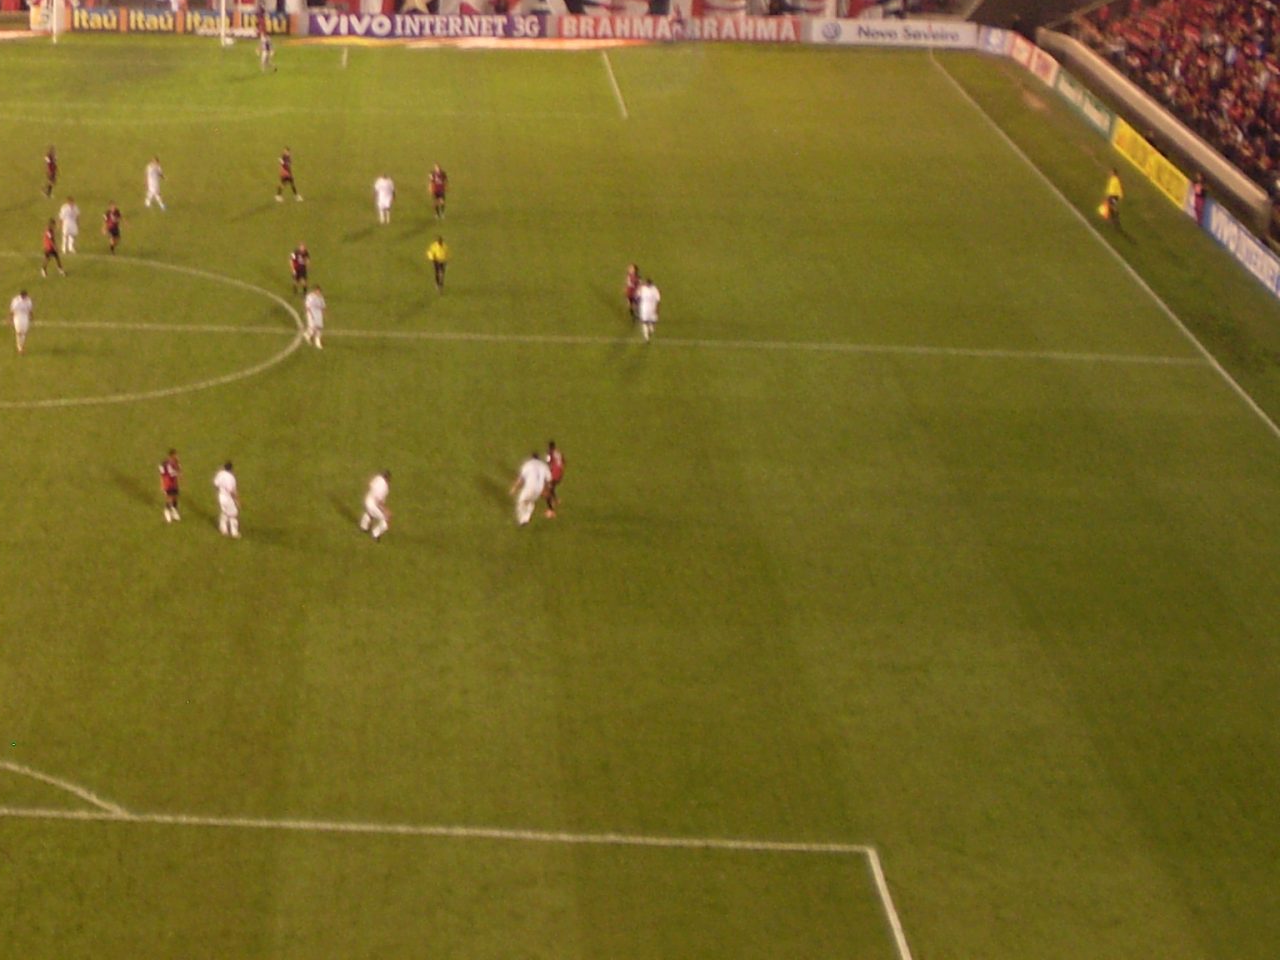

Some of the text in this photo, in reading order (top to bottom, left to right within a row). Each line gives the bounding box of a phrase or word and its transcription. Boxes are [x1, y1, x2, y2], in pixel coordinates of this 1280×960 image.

[395, 15, 507, 36] INTERNET
[513, 16, 539, 37] 3G
[563, 16, 796, 41] BRAHMA BRAHMA
